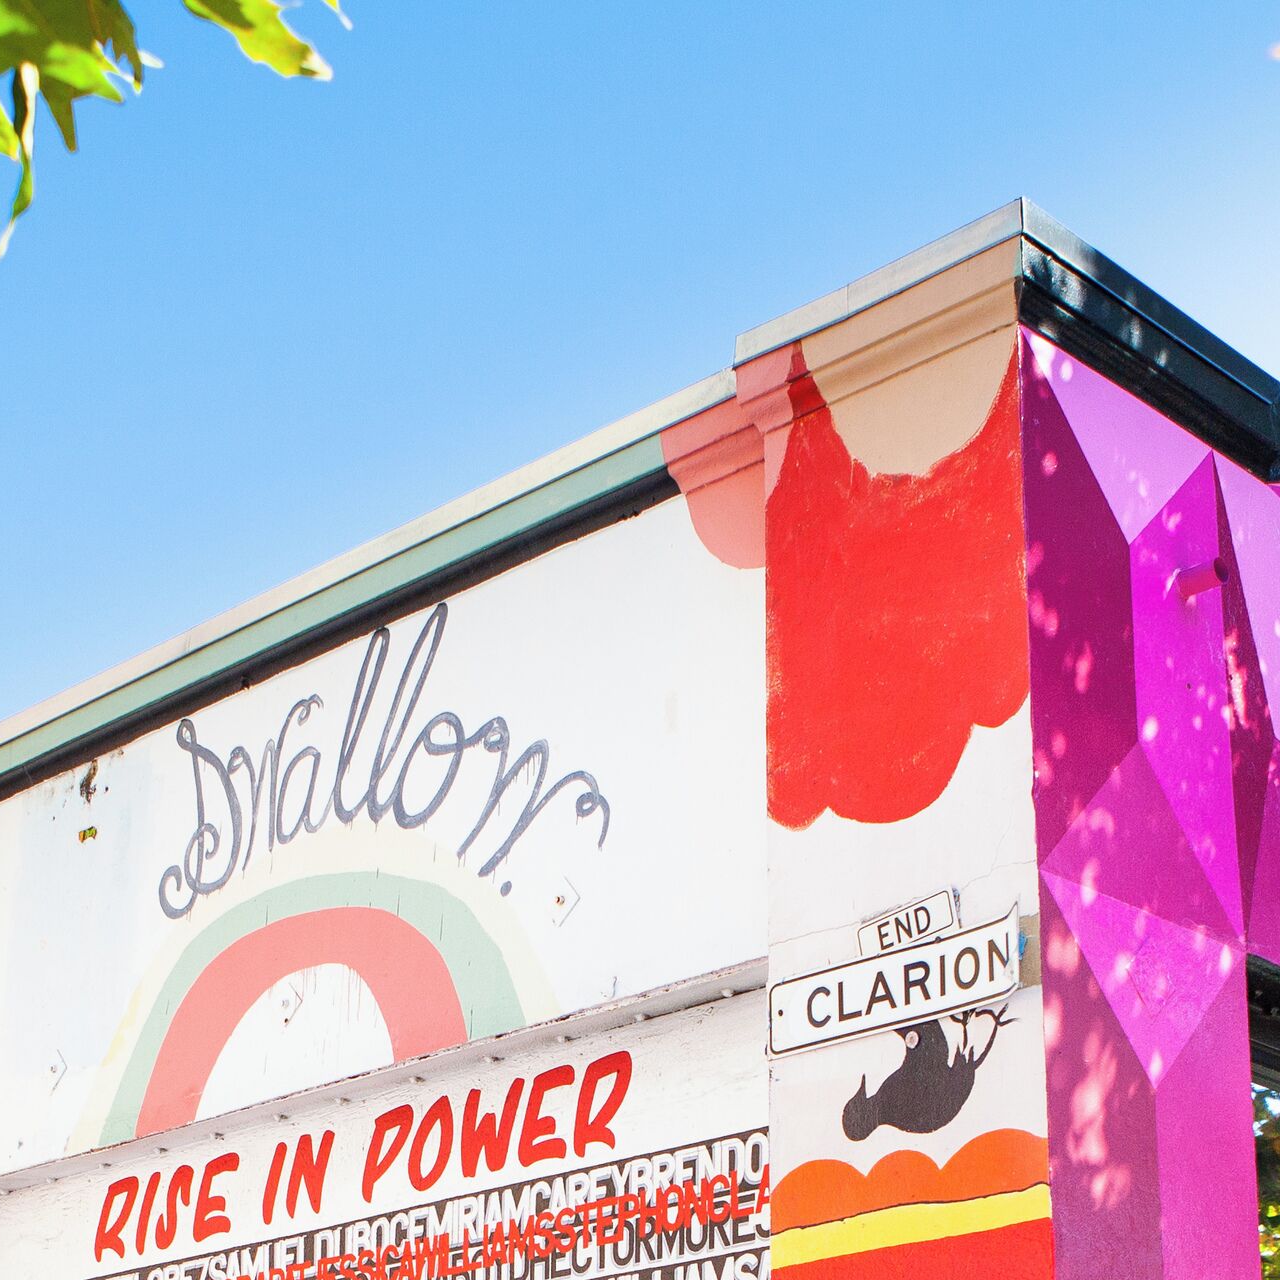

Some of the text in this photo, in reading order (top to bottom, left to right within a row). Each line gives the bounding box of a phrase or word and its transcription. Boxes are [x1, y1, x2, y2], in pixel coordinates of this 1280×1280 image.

[877, 905, 931, 951] END
[806, 931, 1010, 1029] CLARION
[94, 1050, 633, 1263] RISE IN POWER
